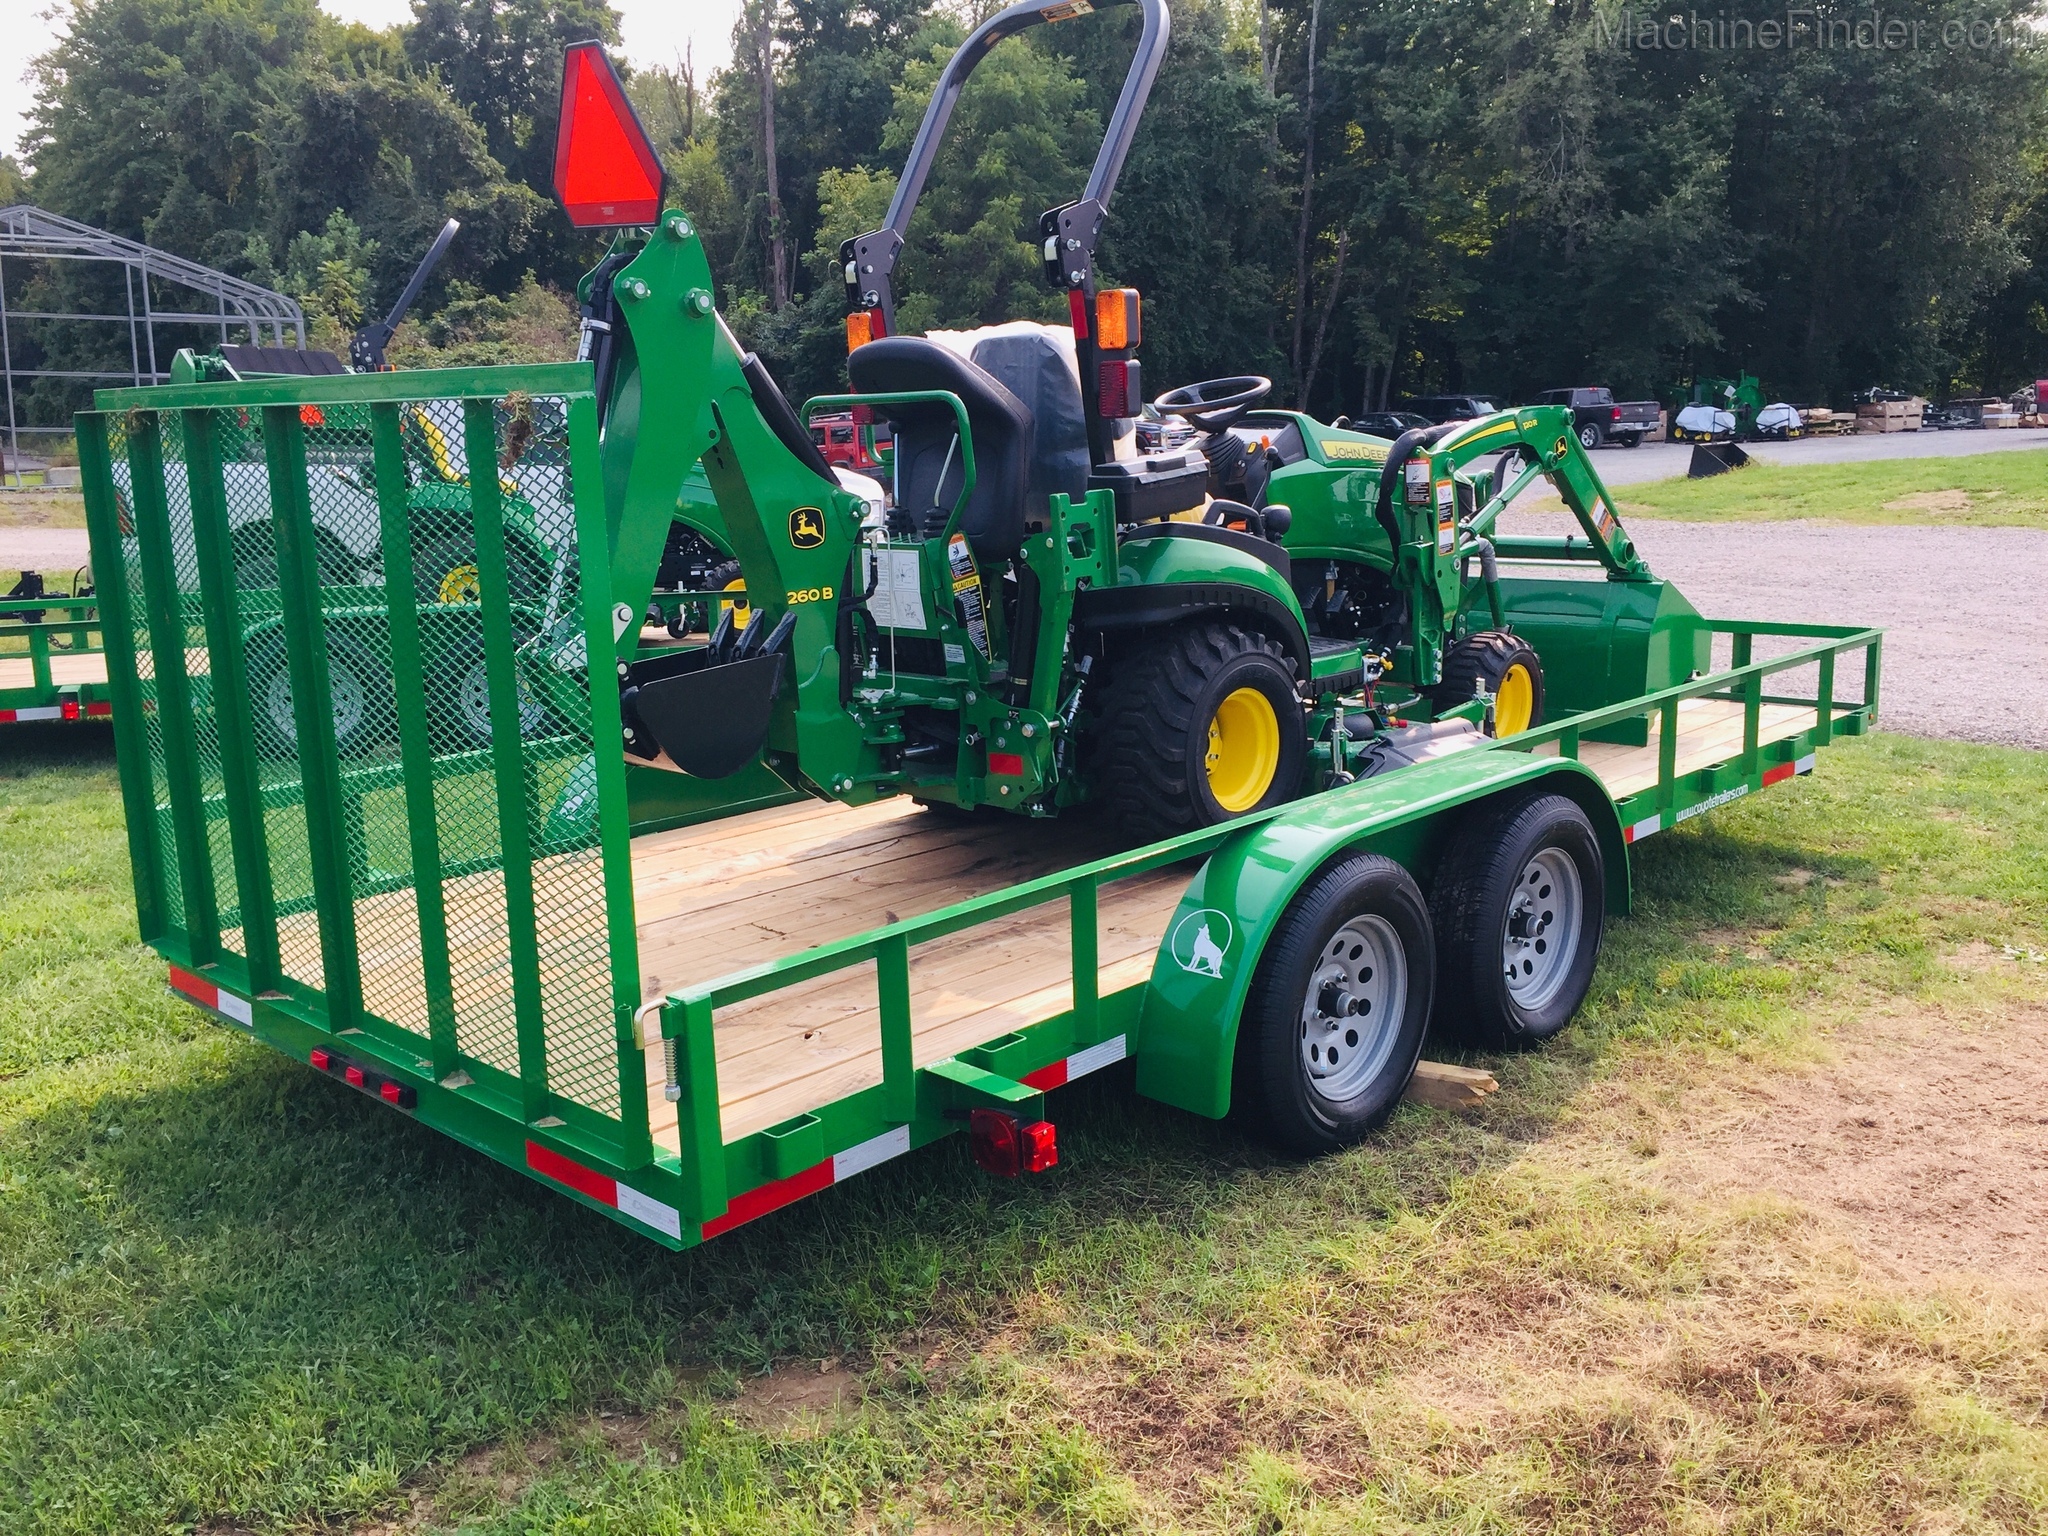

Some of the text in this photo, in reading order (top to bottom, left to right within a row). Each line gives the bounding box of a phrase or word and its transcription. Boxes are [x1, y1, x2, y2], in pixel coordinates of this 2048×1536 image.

[1333, 445, 1388, 460] JOHN DEER
[957, 578, 977, 590] CAUTION
[786, 586, 834, 605] 260 B
[1675, 783, 1749, 822] www.coyotetrailers.com
